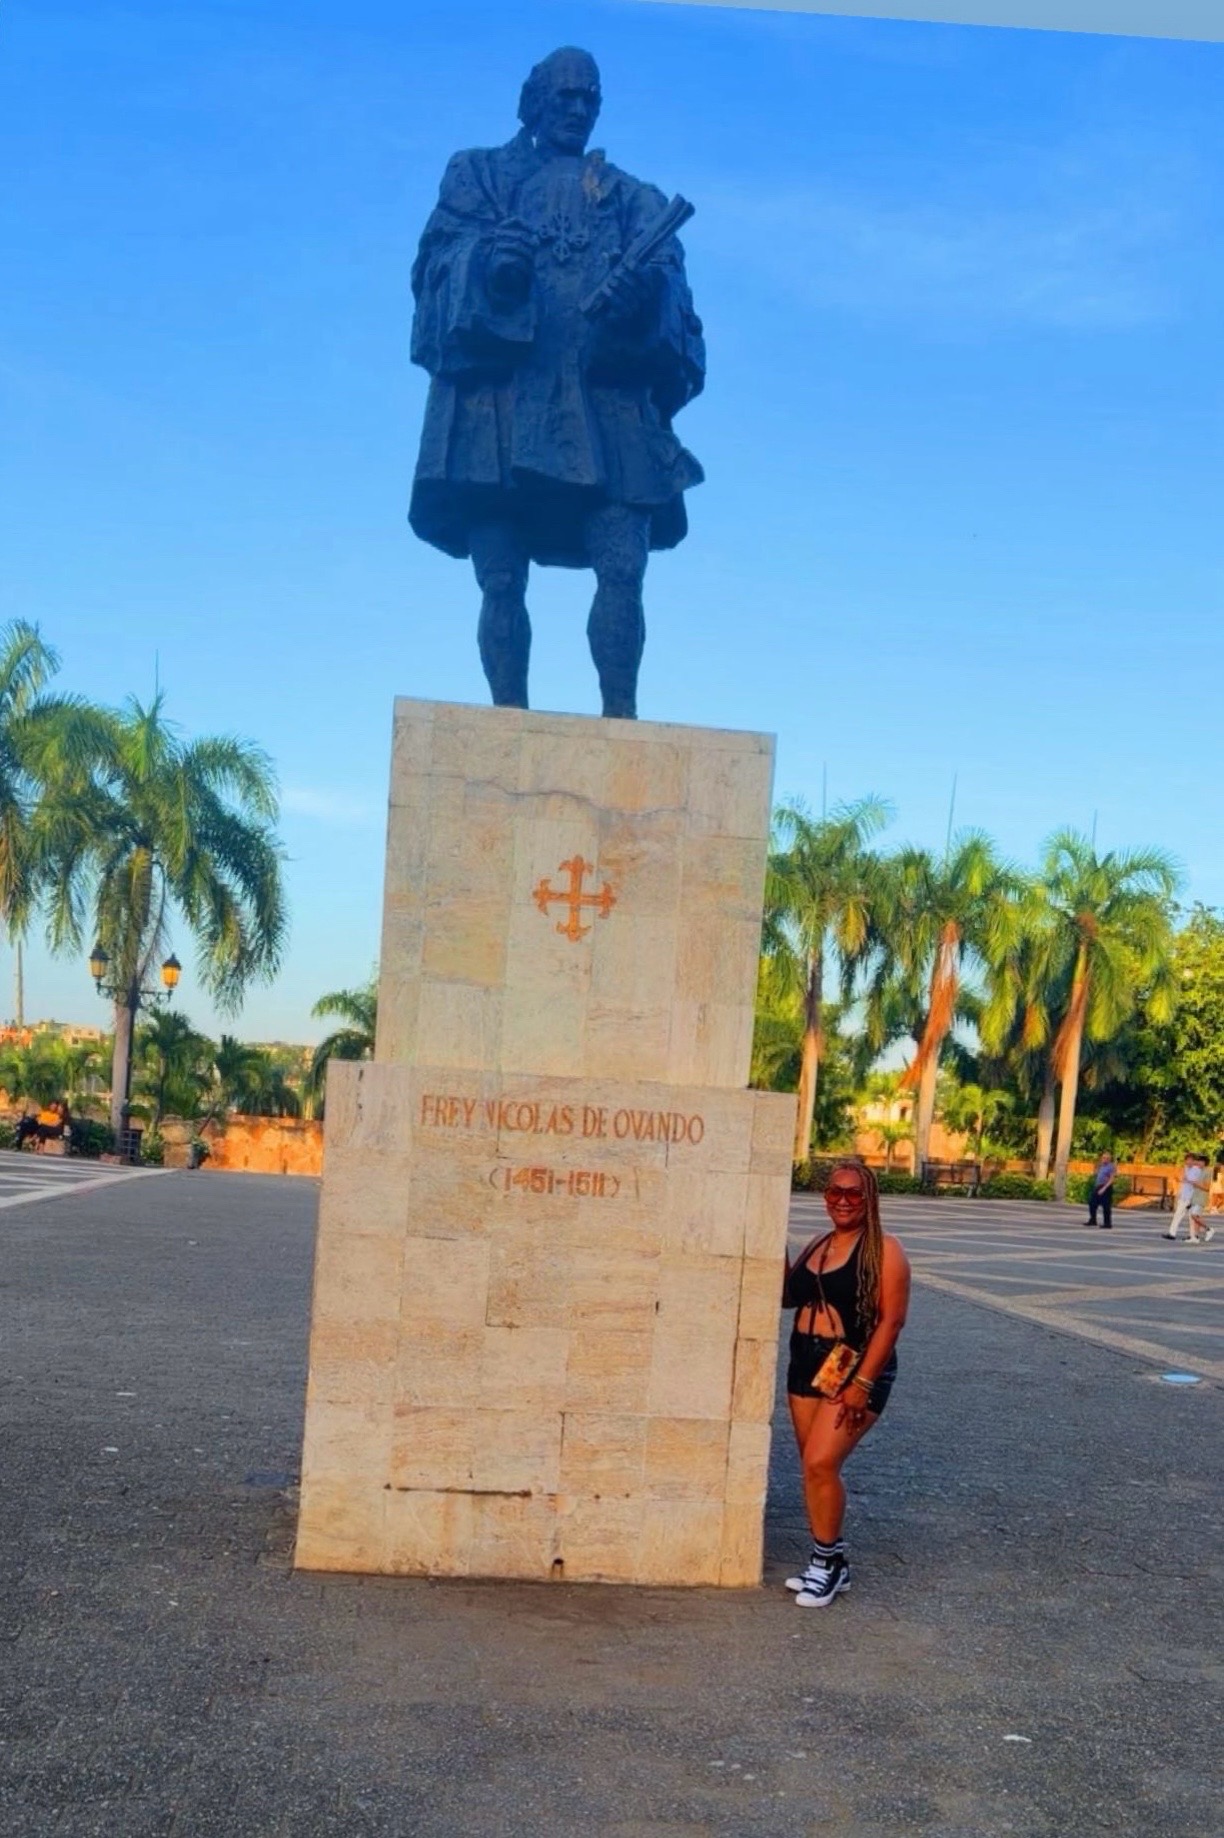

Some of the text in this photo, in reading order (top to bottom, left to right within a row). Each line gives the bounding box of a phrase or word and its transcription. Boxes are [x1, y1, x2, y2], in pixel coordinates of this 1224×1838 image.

[420, 1094, 705, 1146] FREY NICOLAS DE OVANDO
